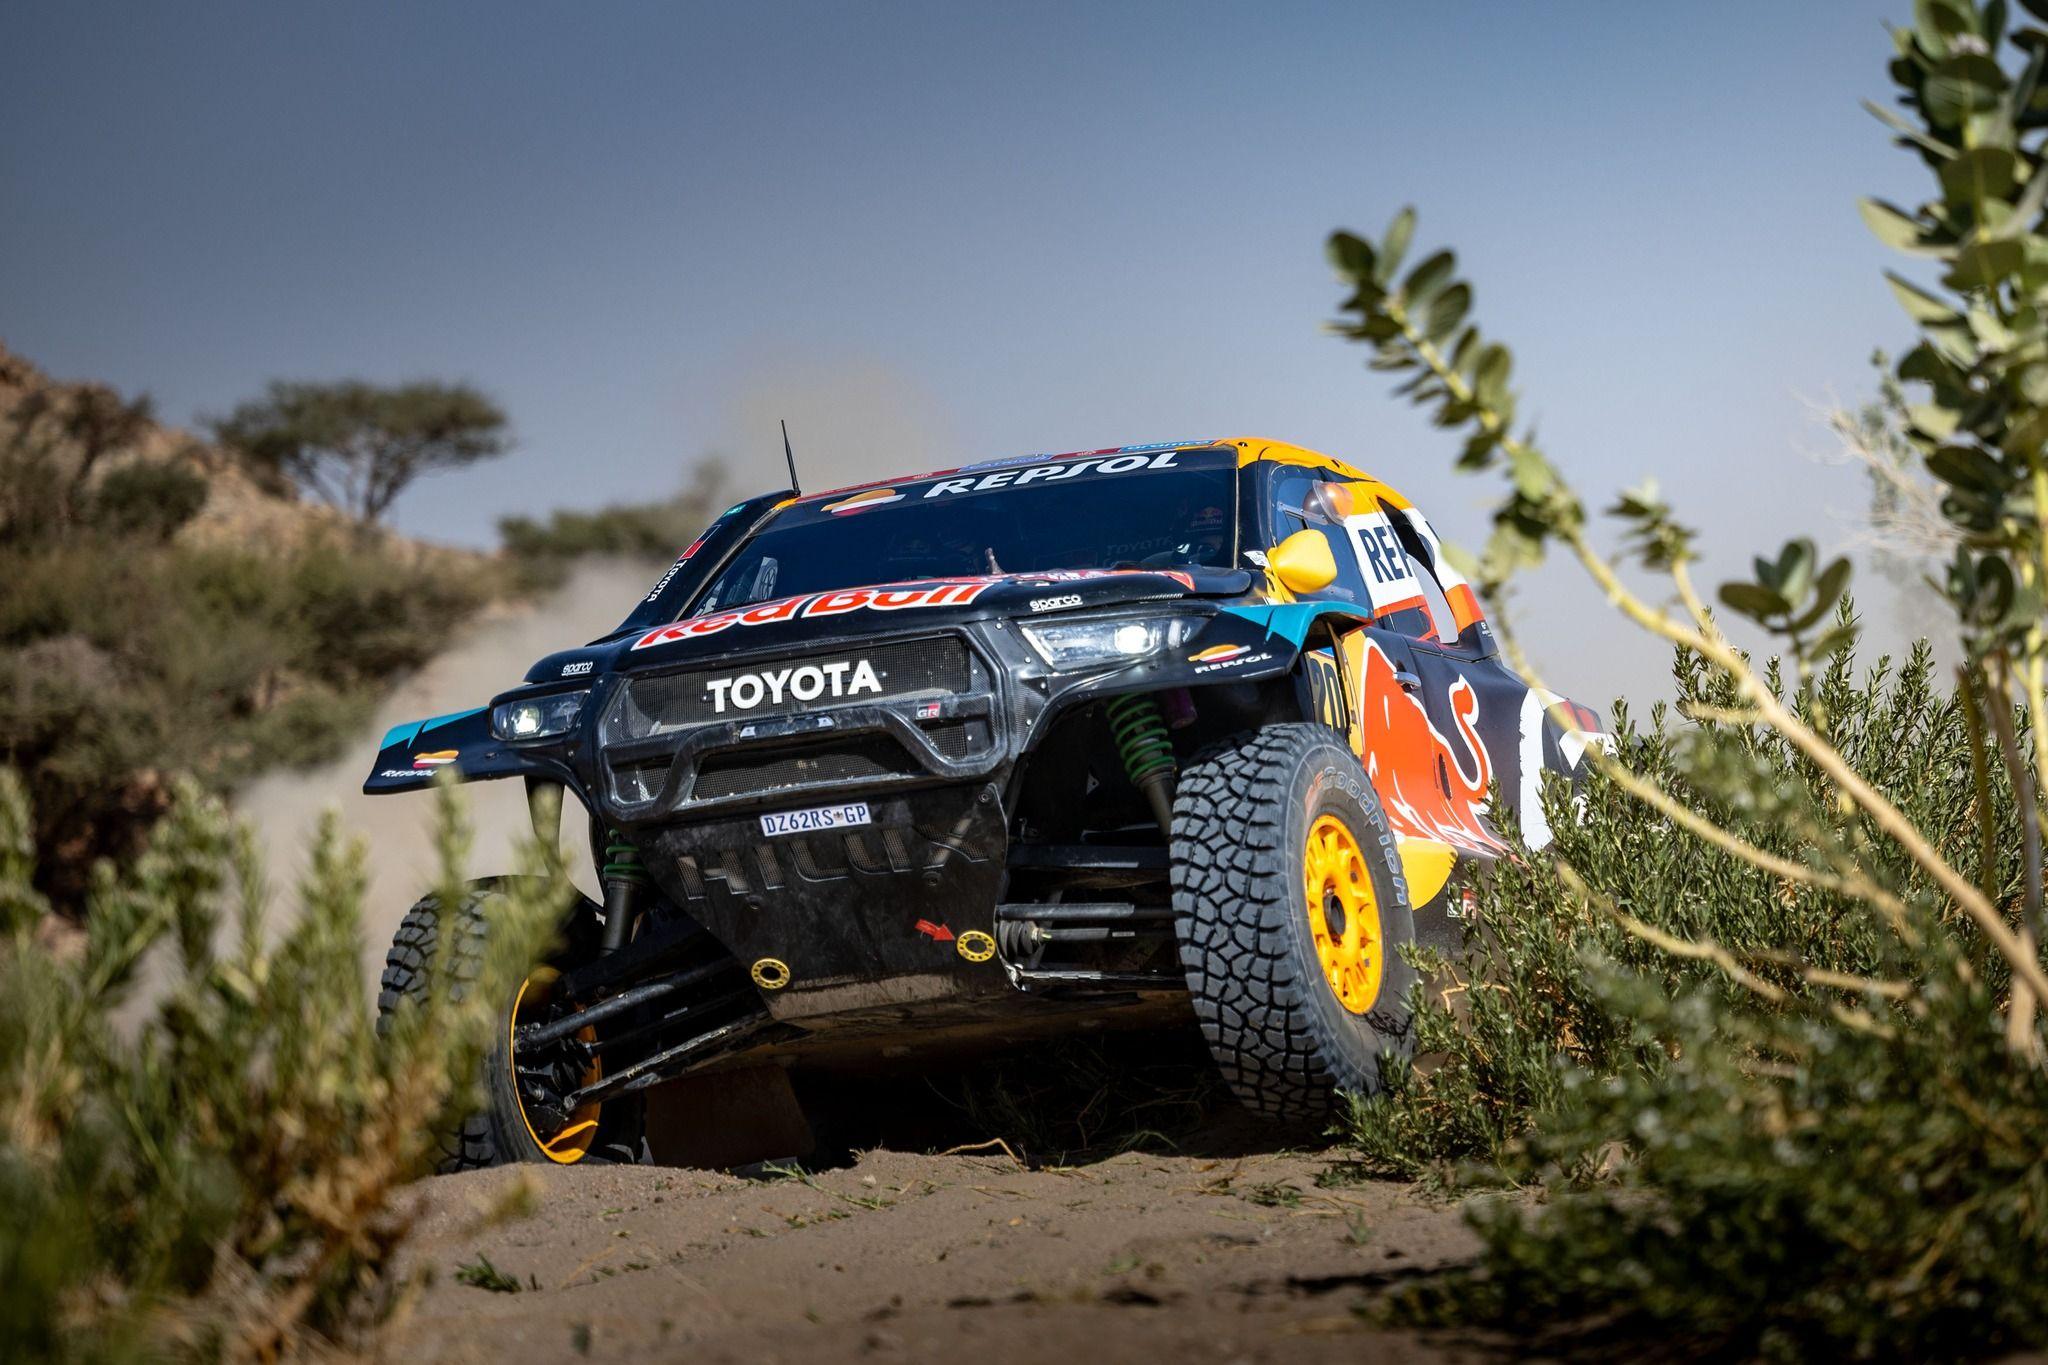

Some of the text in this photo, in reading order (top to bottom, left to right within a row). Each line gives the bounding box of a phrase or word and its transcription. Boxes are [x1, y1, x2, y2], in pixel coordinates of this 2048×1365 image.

[924, 452, 1178, 499] REPSOL
[646, 559, 687, 603] TOYOTA
[1030, 594, 1083, 612] sparco
[631, 583, 995, 651] Red Bull
[561, 661, 594, 677] sparco
[1194, 652, 1273, 674] REPSOL
[706, 659, 882, 713] TOYOTA
[764, 805, 866, 834] DZ62RS GP
[675, 818, 989, 900] HILUX
